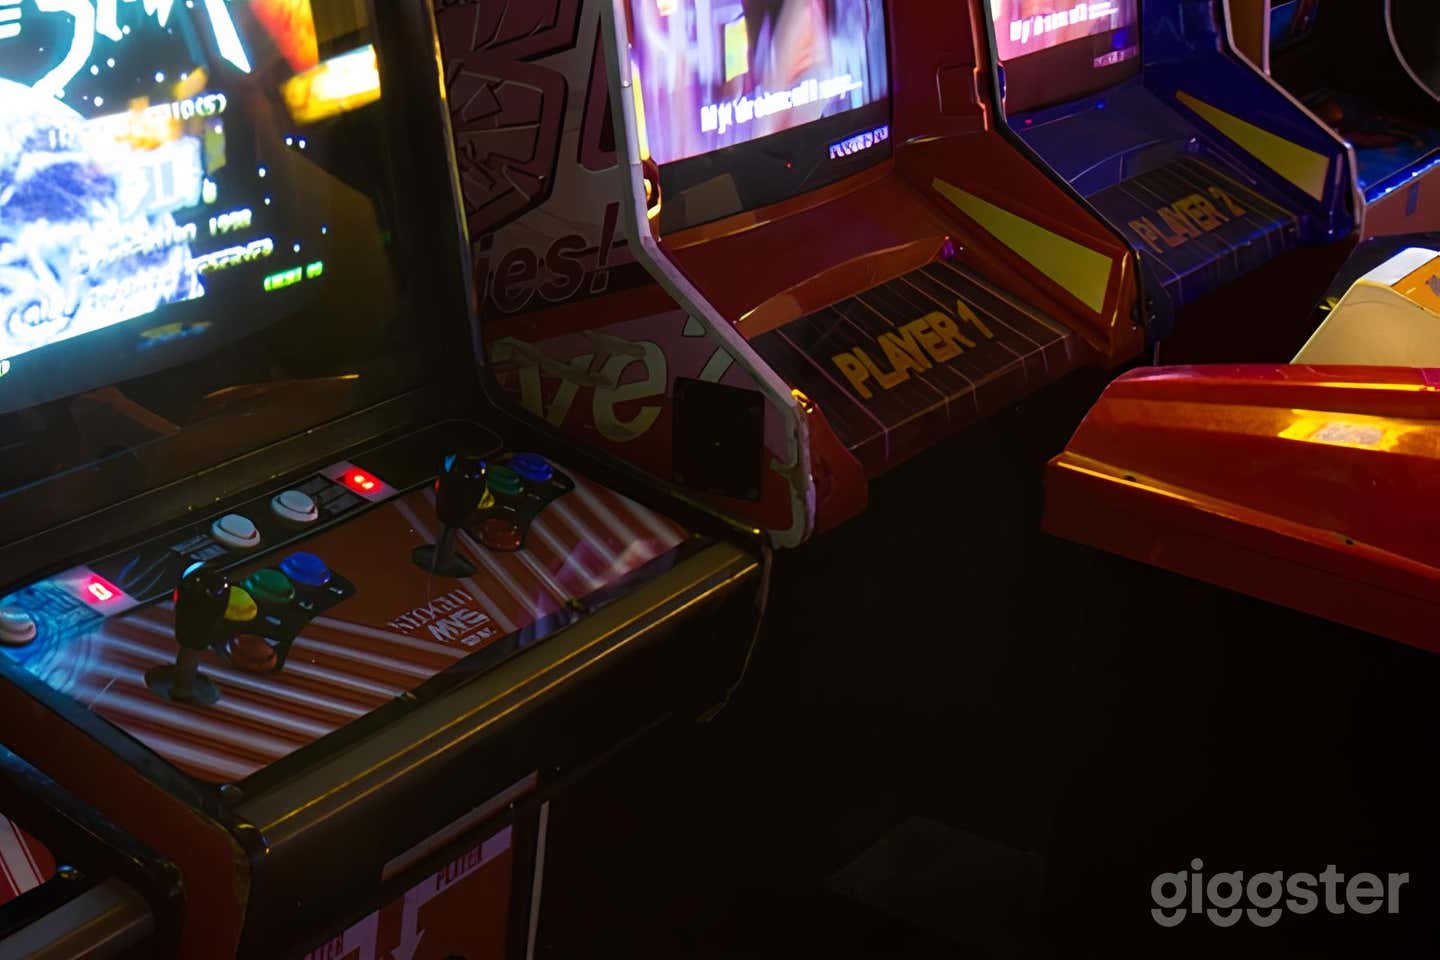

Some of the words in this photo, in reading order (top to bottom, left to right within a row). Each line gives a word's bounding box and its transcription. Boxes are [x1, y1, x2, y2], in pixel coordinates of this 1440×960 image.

[1129, 193, 1228, 255] PLAYER
[1210, 186, 1245, 217] 2
[832, 310, 967, 401] PLAYER
[957, 299, 994, 340] 1
